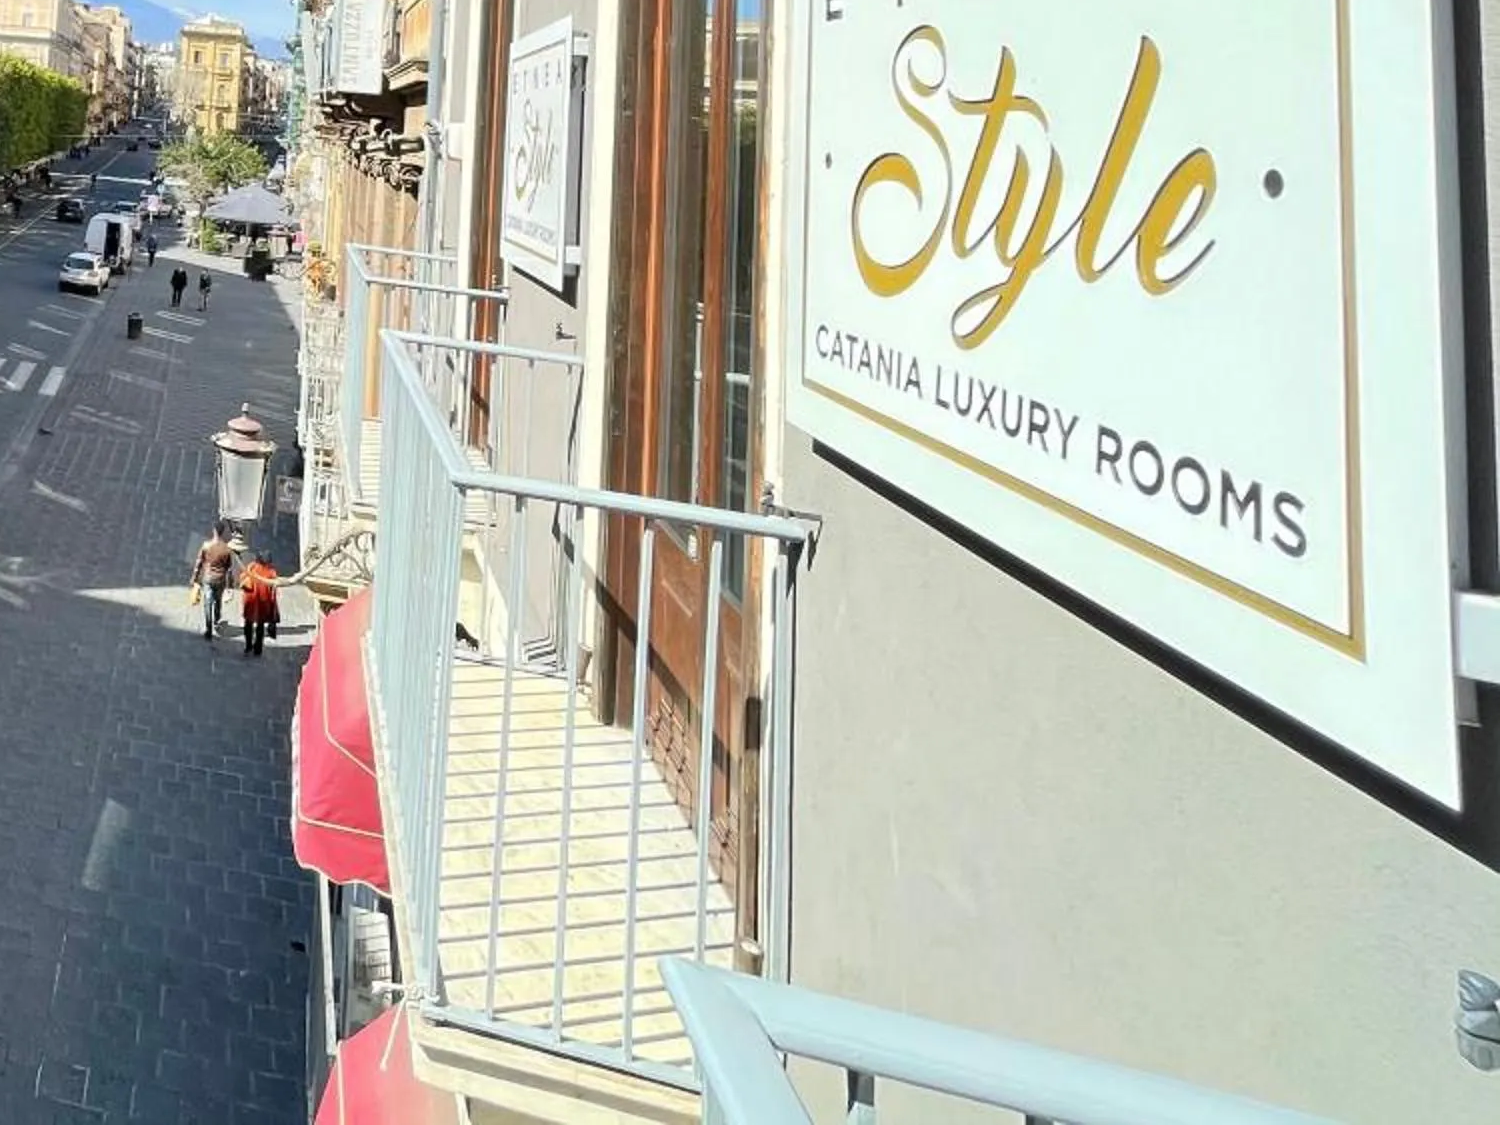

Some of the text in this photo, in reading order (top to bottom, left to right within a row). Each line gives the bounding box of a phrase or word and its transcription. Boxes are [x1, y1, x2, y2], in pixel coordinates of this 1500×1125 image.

[513, 59, 563, 95] ETNEA
[514, 98, 555, 215] Style
[851, 24, 1217, 351] Style
[815, 324, 1308, 559] CATANIA LUXURY ROOMS
